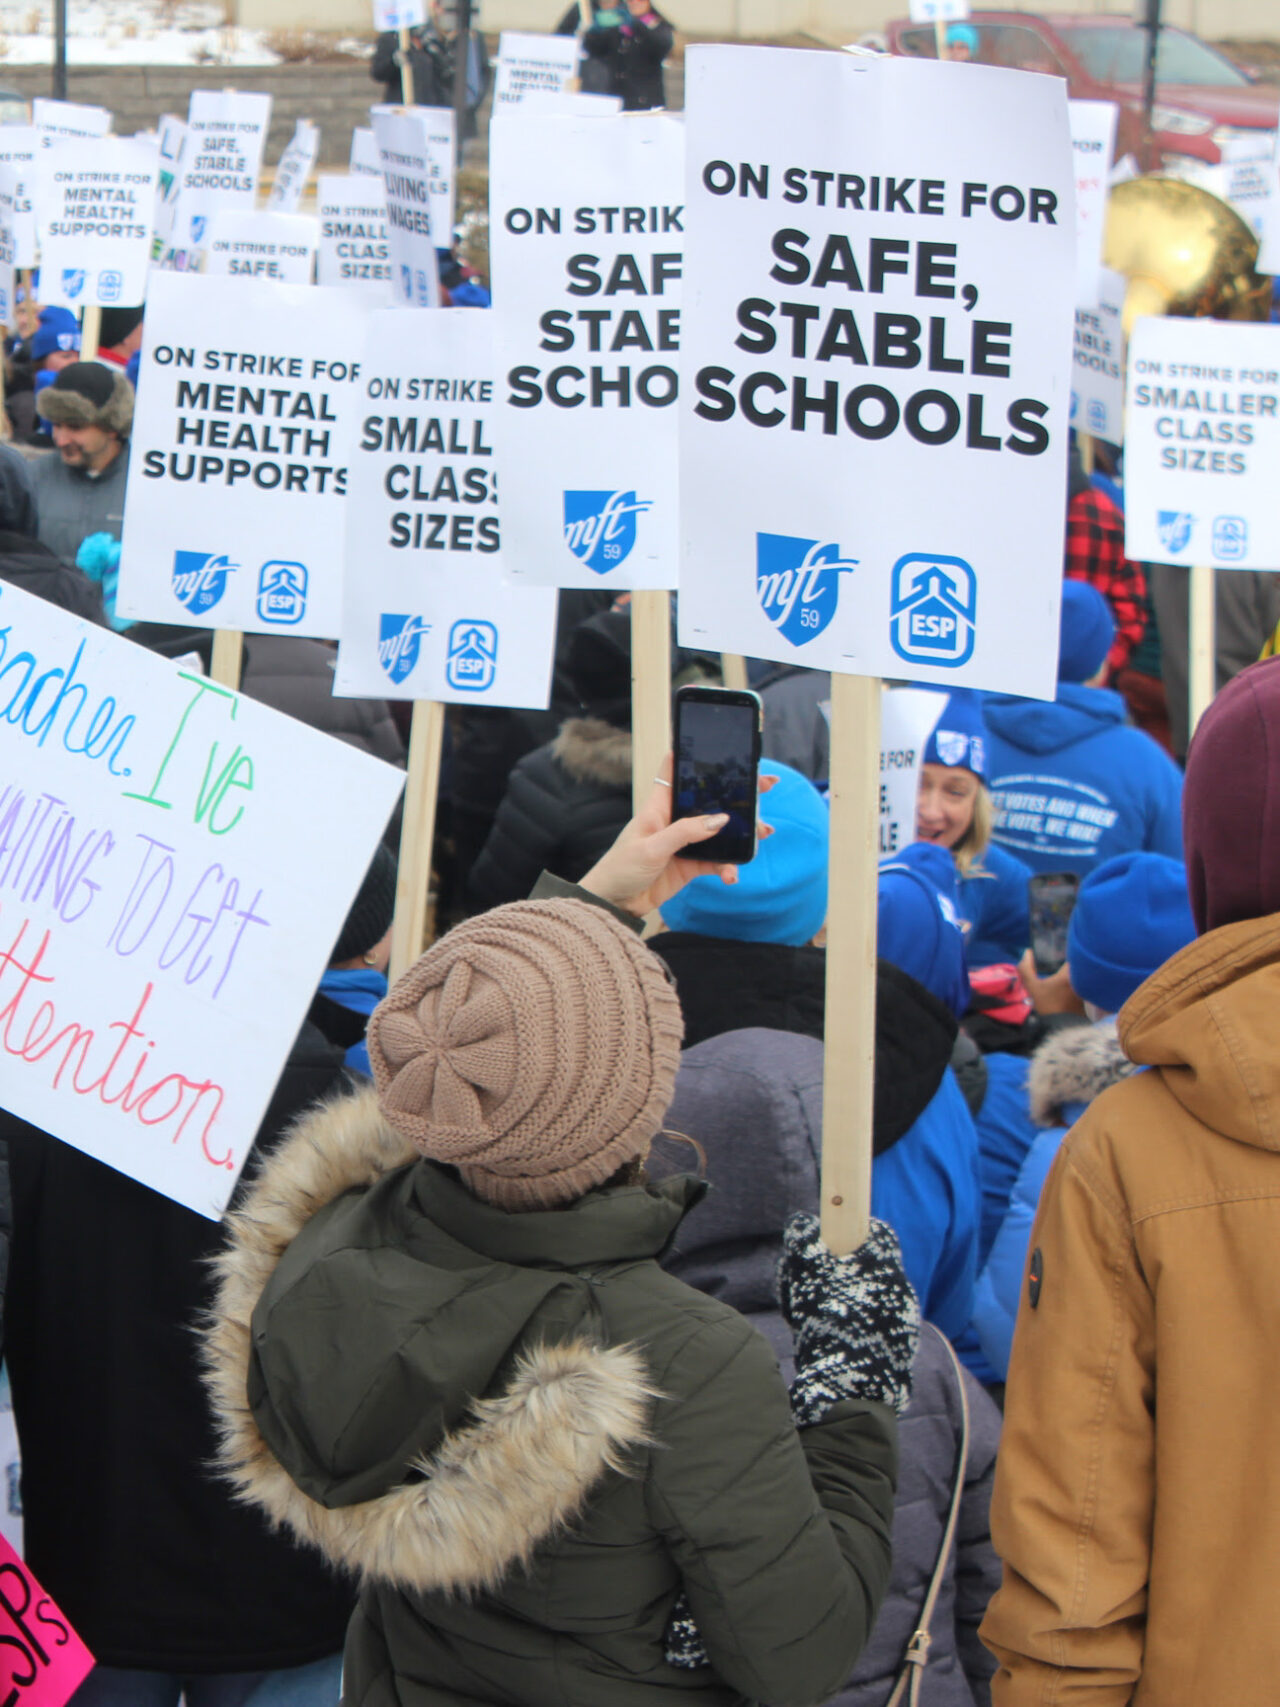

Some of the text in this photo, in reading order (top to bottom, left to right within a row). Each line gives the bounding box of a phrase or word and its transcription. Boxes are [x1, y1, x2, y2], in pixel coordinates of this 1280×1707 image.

[194, 156, 245, 172] STABLE
[55, 173, 151, 184] ON STRIKE FOR
[184, 175, 252, 191] SCHOOLS
[385, 172, 427, 203] LIVING
[64, 188, 136, 203] MENTAL
[702, 160, 769, 199] ON
[783, 167, 945, 215] STRIKE
[961, 182, 1058, 225] FOR
[64, 205, 134, 220] HEALTH
[322, 206, 340, 215] ON
[387, 203, 430, 237] WAGES
[505, 208, 561, 234] ON
[49, 222, 146, 238] SUPPORTS
[234, 242, 308, 257] STRIKE FOR
[769, 228, 979, 312] SAFE,
[734, 297, 1012, 378] STABLE
[153, 345, 195, 367] ON
[203, 351, 302, 378] STRIKE
[1135, 360, 1279, 384] ON STRIKE FOR
[176, 380, 336, 421] MENTAL
[368, 378, 493, 402] ON STRIKE
[1135, 385, 1278, 417] SMALLER
[693, 365, 1050, 456] SCHOOLS
[177, 418, 330, 457] HEALTH
[1156, 417, 1254, 445] CLASS
[1161, 447, 1246, 475] SIZES
[389, 512, 500, 554] SIZES
[603, 544, 621, 559] 59
[758, 541, 860, 628] mft
[270, 595, 293, 609] ESP
[801, 608, 819, 628] 59
[912, 615, 955, 638] ESP
[459, 659, 483, 674] ESP
[1006, 792, 1118, 828] VOTES WHEN
[1045, 817, 1066, 837] WE
